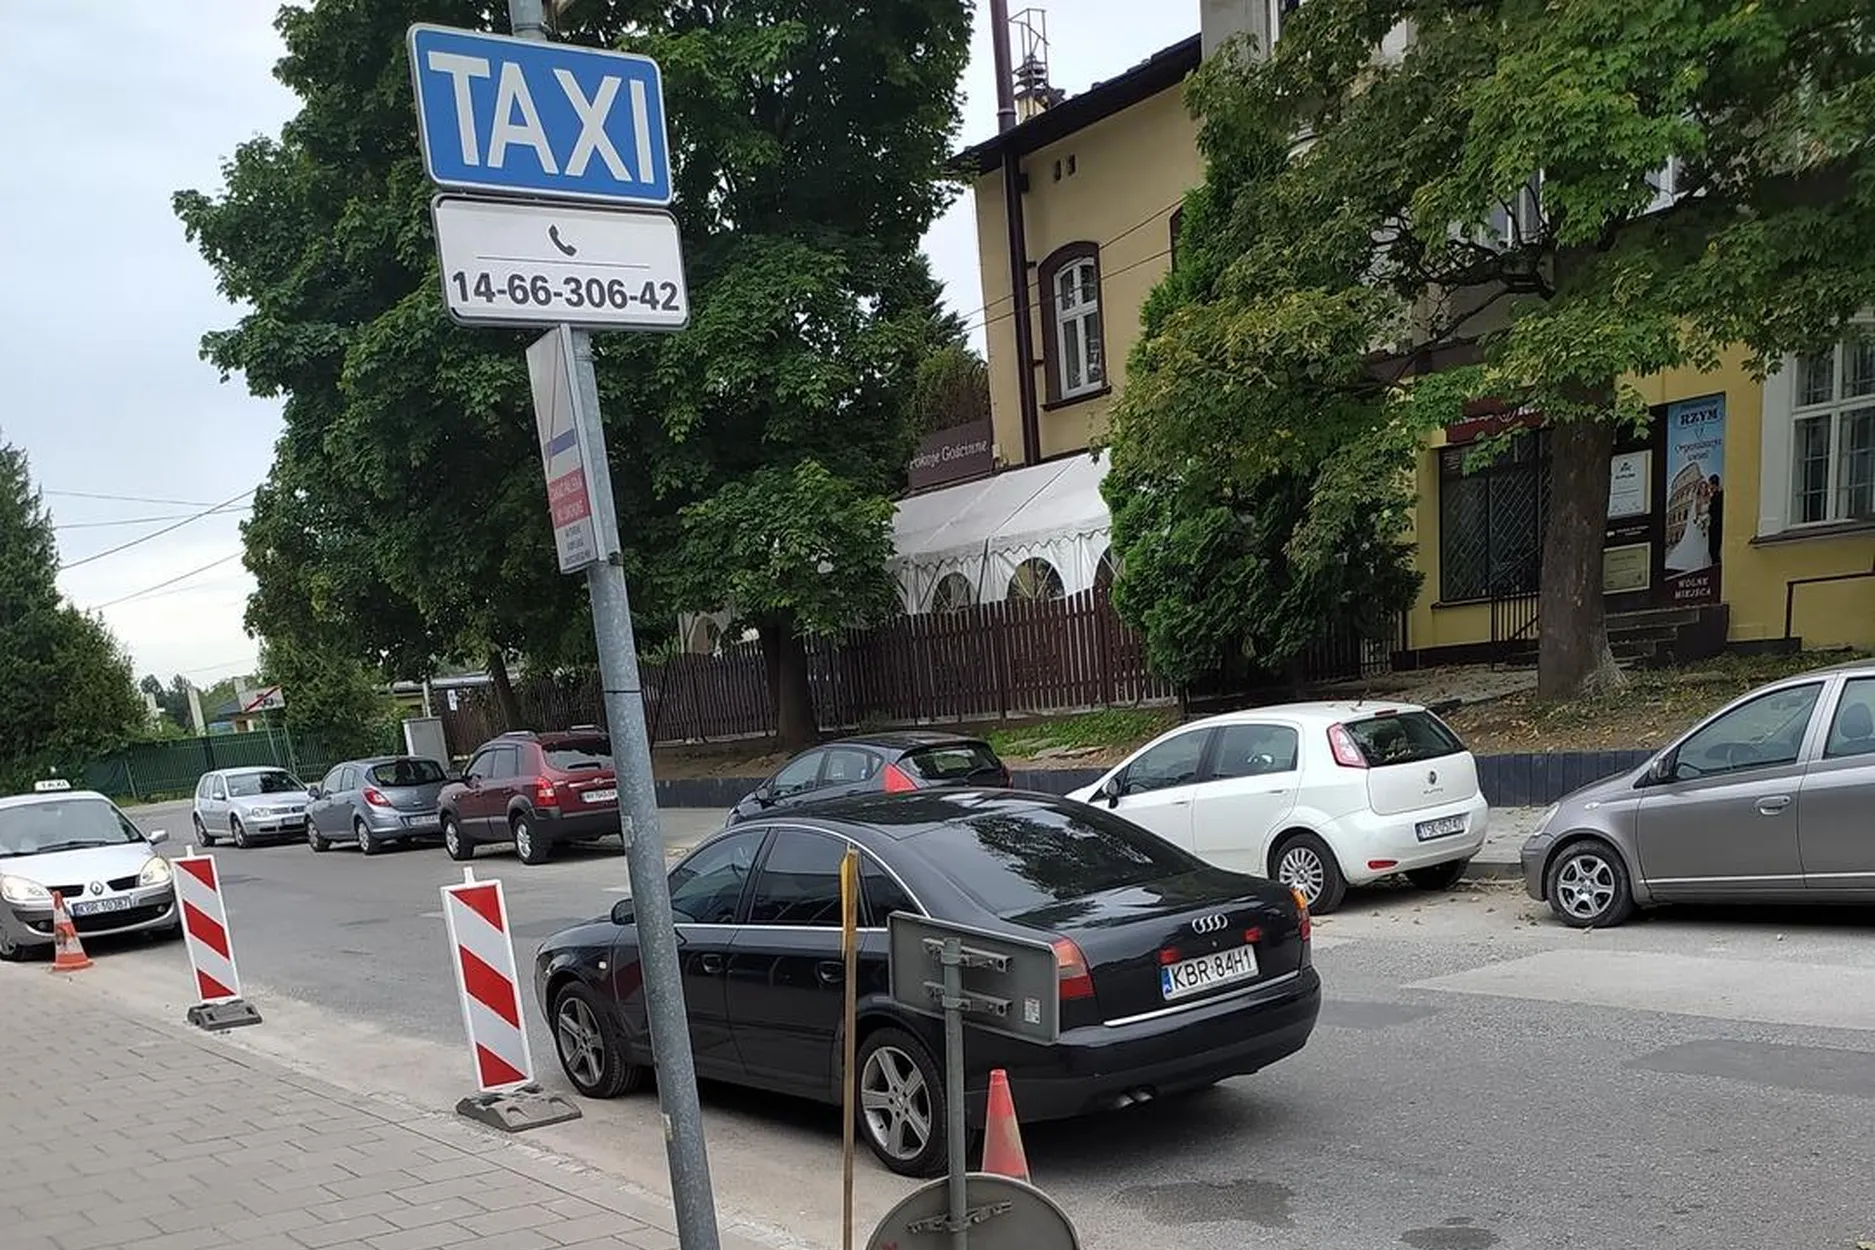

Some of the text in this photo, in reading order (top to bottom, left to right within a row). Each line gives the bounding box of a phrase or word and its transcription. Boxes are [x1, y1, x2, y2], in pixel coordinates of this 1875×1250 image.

[428, 51, 654, 184] TAXI
[452, 271, 680, 312] 14-66-306-42
[1681, 409, 1718, 425] RZYM
[1675, 587, 1711, 599] MIEJSCA
[1679, 577, 1709, 588] WOLNE
[1172, 947, 1252, 989] KBR 84H1
